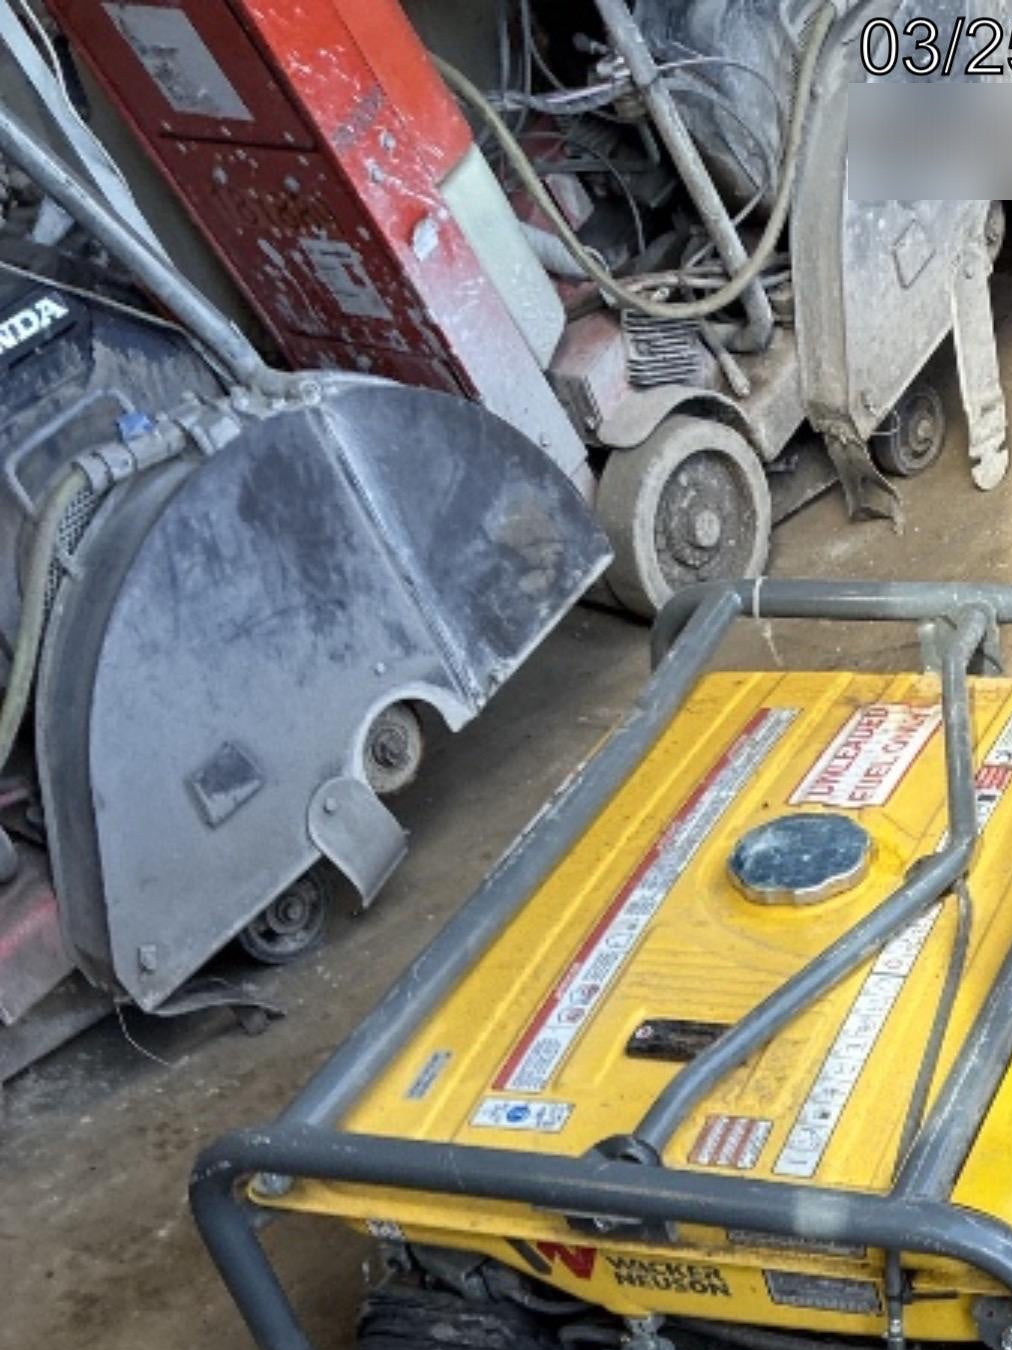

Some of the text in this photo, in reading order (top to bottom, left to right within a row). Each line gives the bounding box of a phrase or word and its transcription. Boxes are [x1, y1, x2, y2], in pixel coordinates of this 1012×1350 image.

[806, 706, 888, 796] UNLEADED
[847, 756, 900, 802] FUEL
[605, 1255, 724, 1282] WACKER
[614, 1271, 732, 1298] NEUSON
